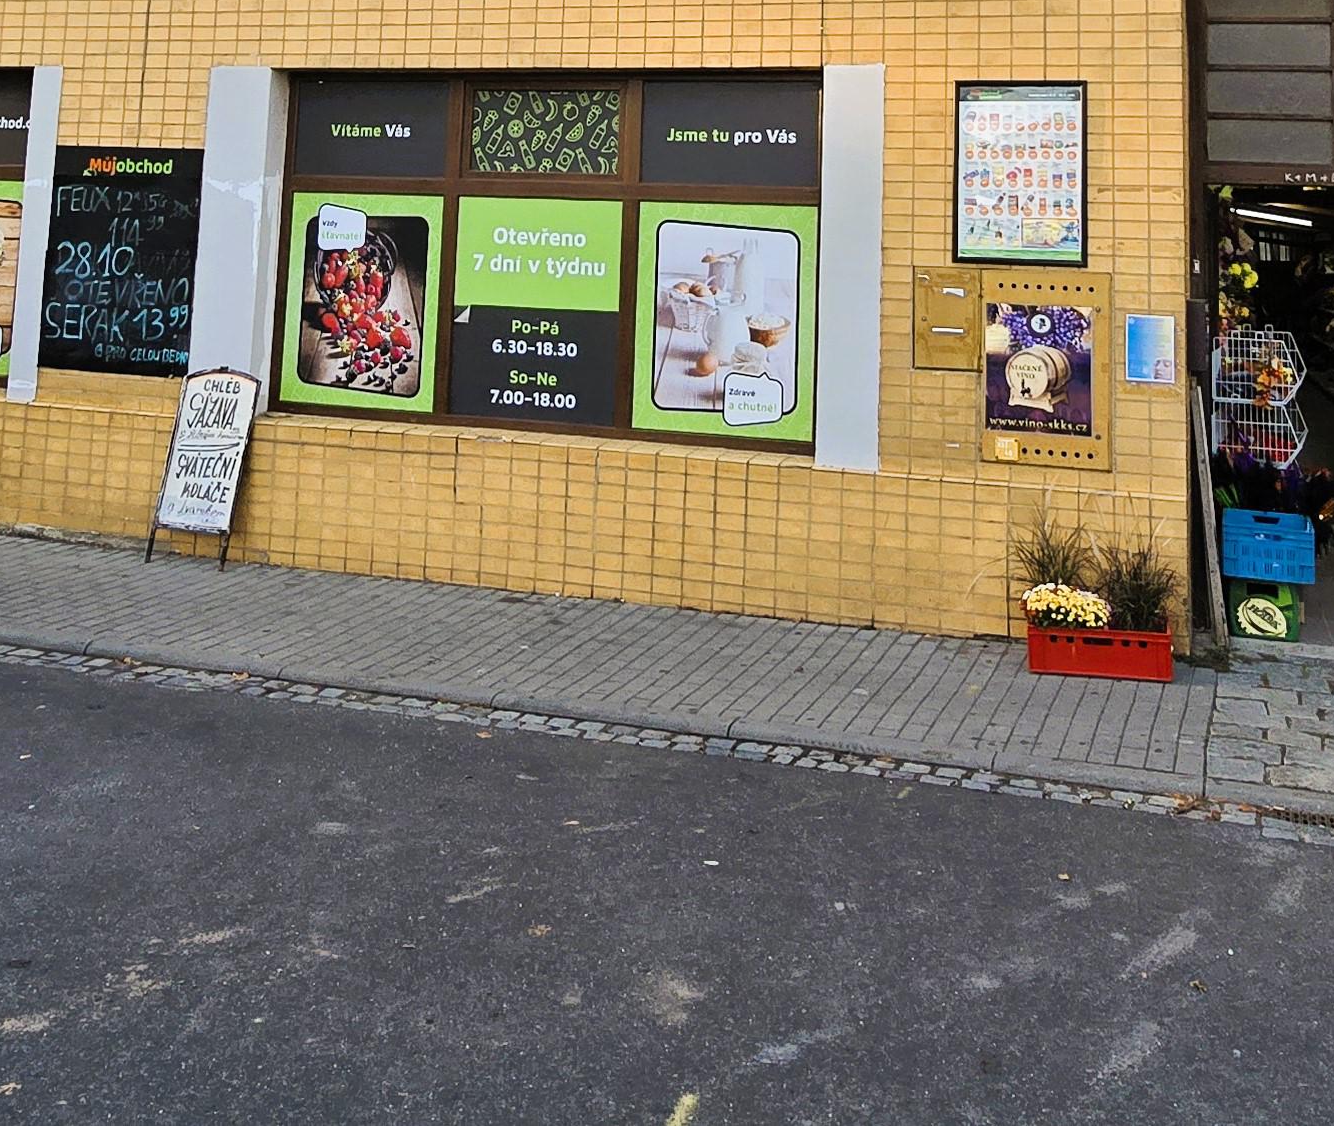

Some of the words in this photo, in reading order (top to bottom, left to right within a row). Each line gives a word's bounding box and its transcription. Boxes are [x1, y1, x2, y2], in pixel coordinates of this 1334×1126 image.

[331, 123, 382, 137] Vítáme
[385, 123, 411, 137] Vás
[667, 127, 708, 142] Jsme
[712, 129, 729, 143] tu
[734, 131, 762, 146] pro
[766, 128, 797, 144] Vás
[493, 227, 587, 248] Otevřeno
[473, 253, 485, 272] 7
[490, 253, 522, 273] dní
[527, 259, 541, 274] v
[547, 256, 606, 279] týdnu
[180, 481, 231, 504] KOLÁČE
